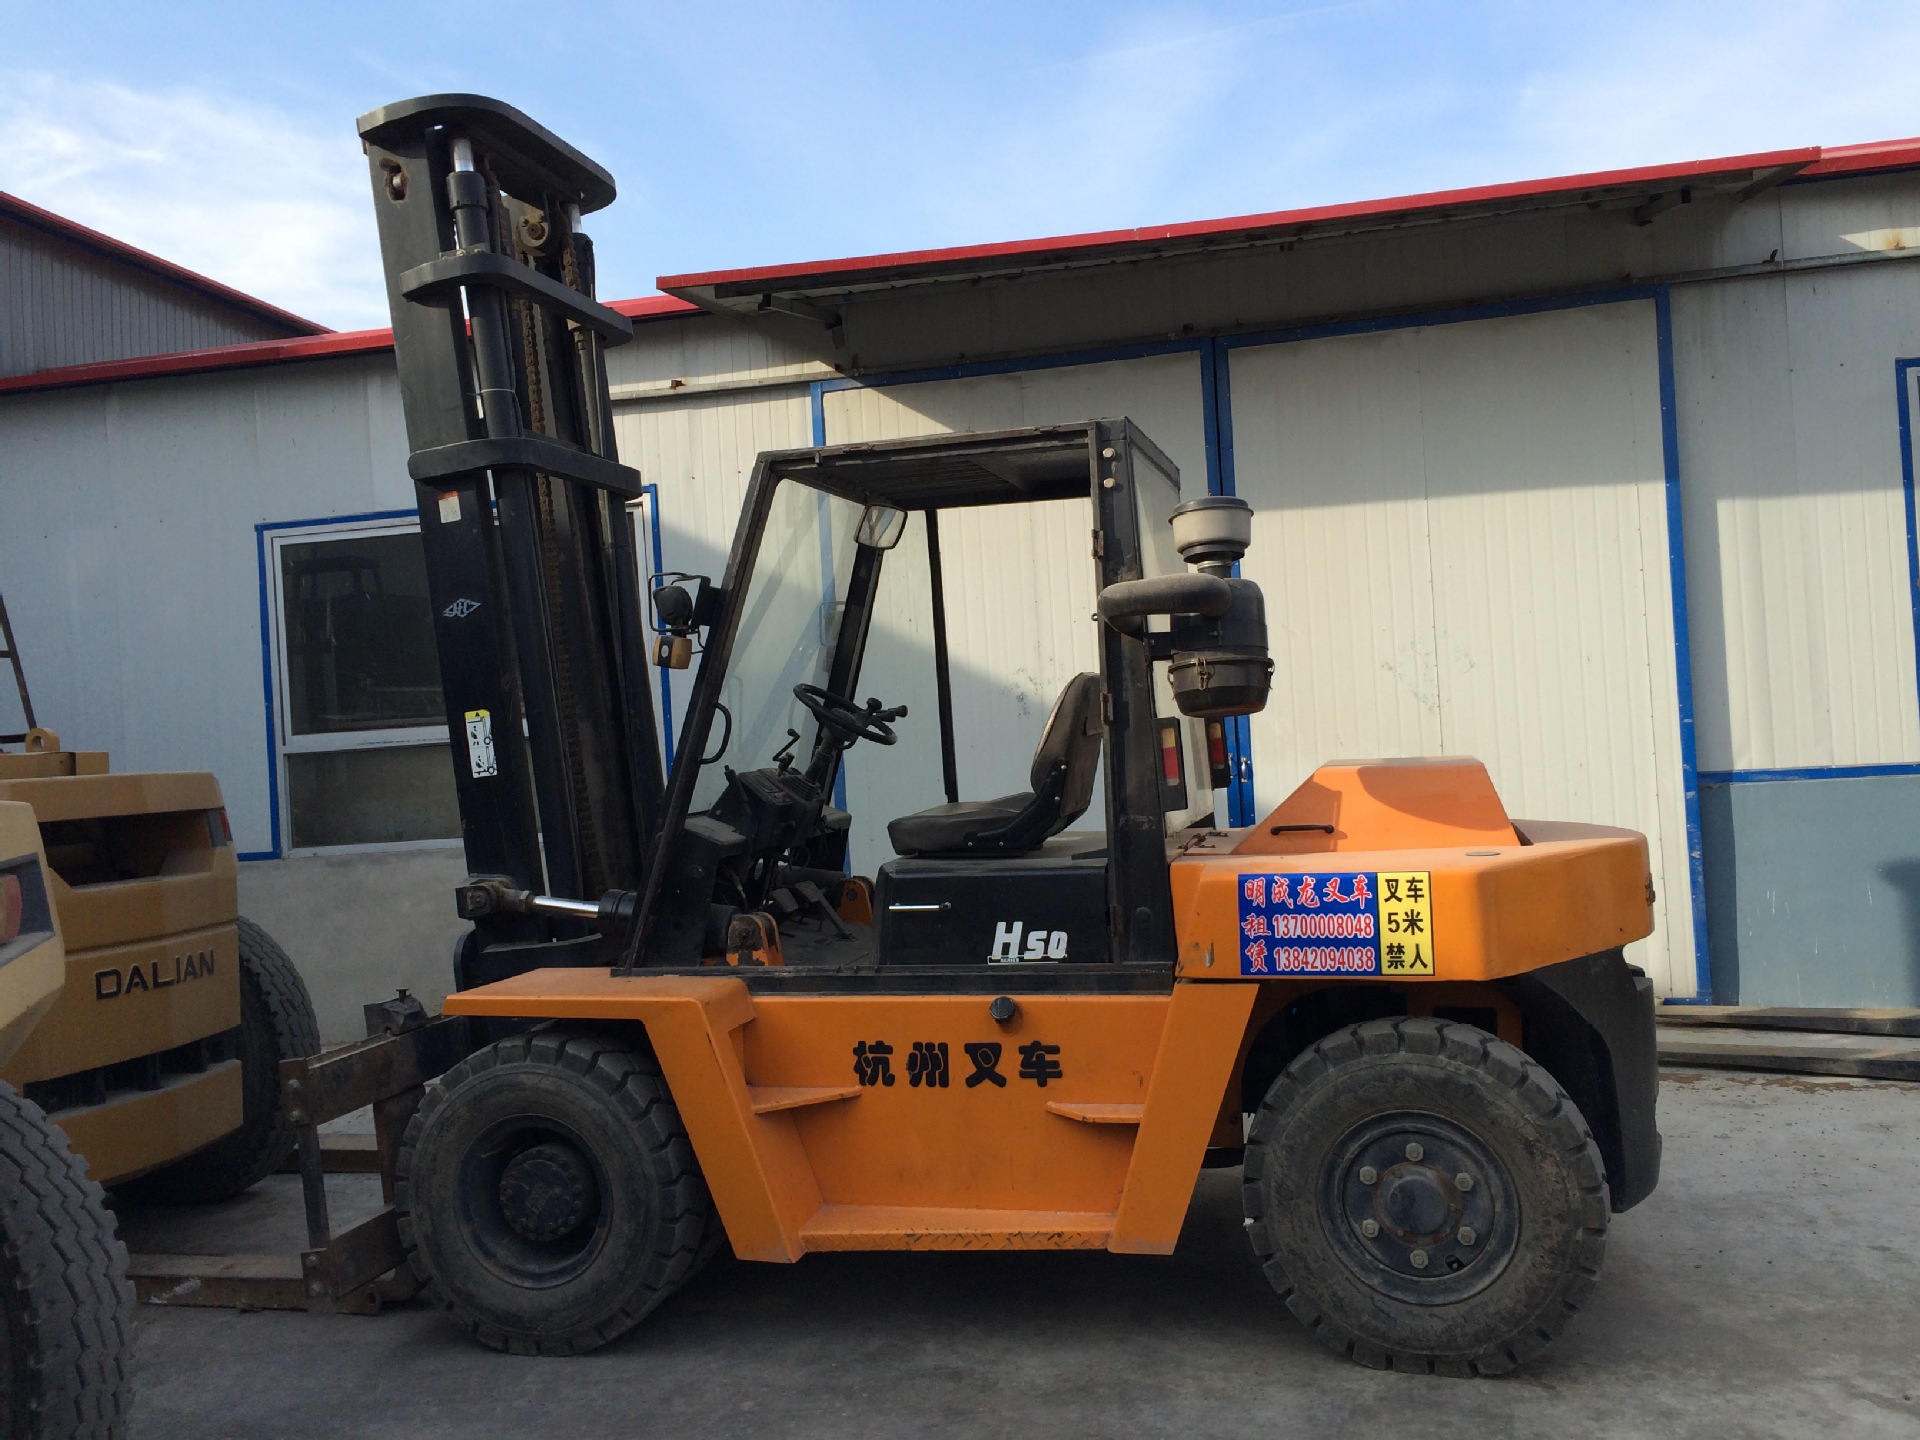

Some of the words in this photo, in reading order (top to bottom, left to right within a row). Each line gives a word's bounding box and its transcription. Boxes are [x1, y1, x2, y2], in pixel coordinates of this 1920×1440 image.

[1384, 877, 1424, 903] 叉车
[1272, 913, 1374, 938] 13700008048
[1387, 909, 1424, 936] 5米
[1273, 946, 1376, 971] 13842094038
[1386, 942, 1428, 970] 禁人
[95, 947, 215, 1000] DALIAN
[852, 1040, 1063, 1088] 杭州叉车
